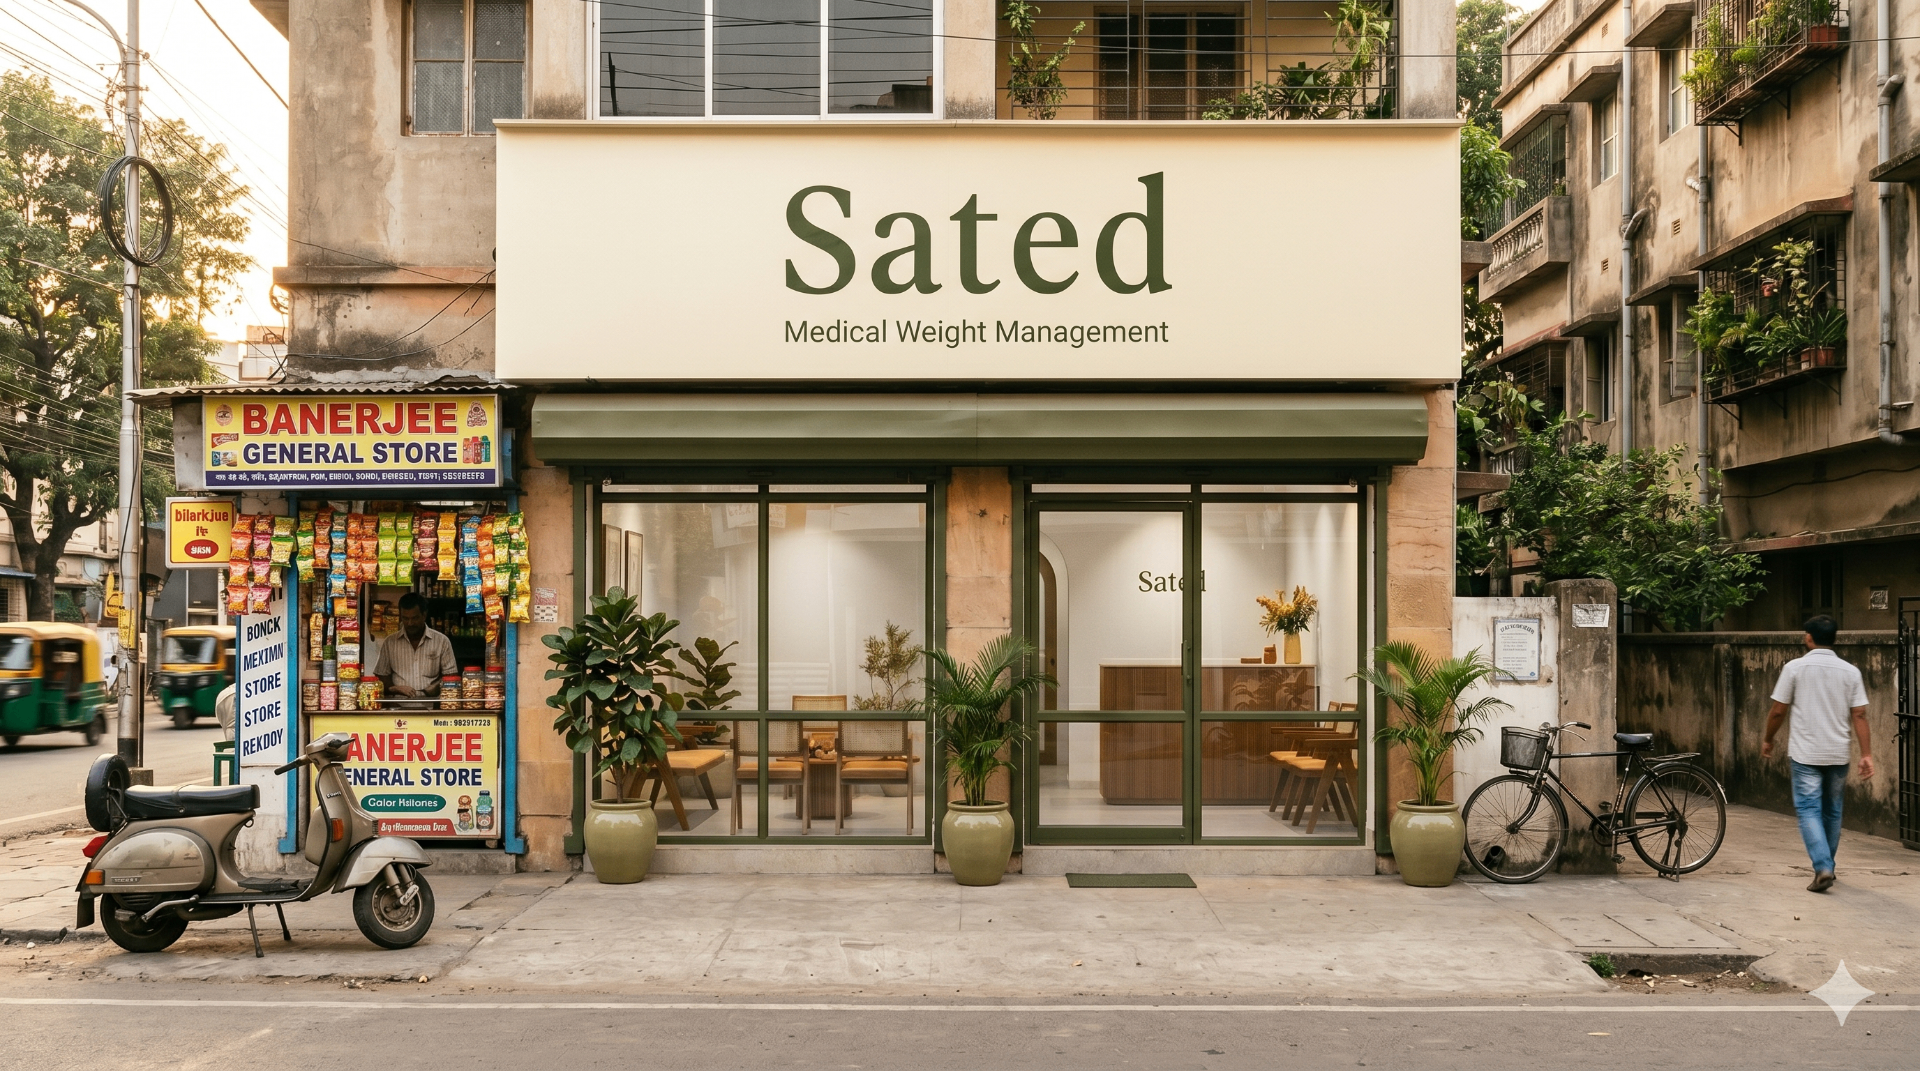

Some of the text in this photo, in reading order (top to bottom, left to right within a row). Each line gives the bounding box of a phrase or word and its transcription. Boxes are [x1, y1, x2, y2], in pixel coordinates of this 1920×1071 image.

[785, 171, 1172, 295] Sated
[785, 319, 1169, 348] Medical Weight Management
[243, 402, 458, 435] BANERJEE
[243, 442, 457, 464] GENERAL STORE
[246, 616, 282, 642] BONCK
[243, 642, 284, 671] MEXIMN
[245, 671, 282, 699] STORE
[244, 700, 282, 728] STORE
[243, 728, 284, 757] REKDOY
[345, 732, 483, 762] ANERJEE
[343, 767, 482, 786] ENERAL STORE
